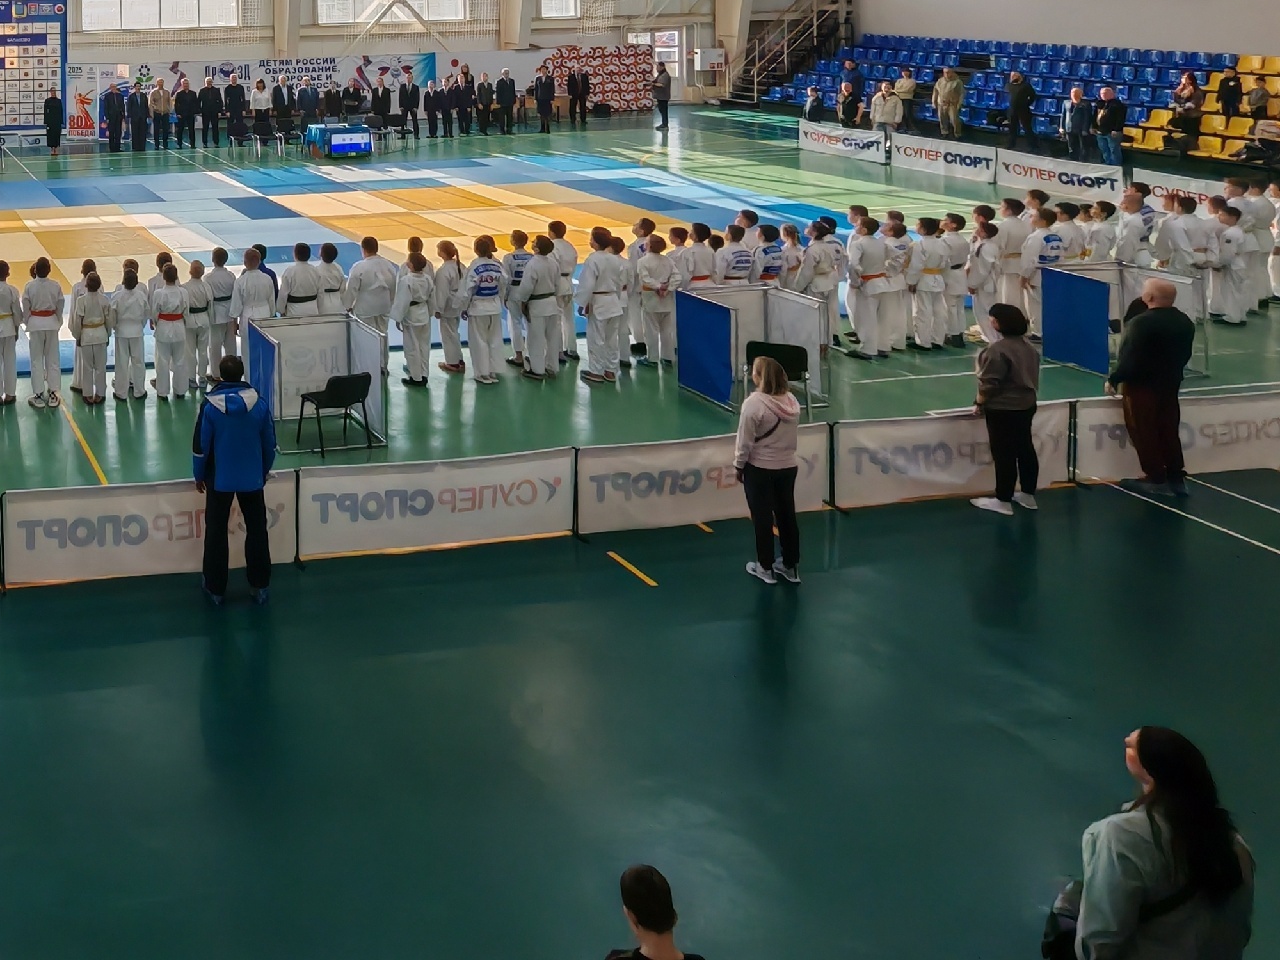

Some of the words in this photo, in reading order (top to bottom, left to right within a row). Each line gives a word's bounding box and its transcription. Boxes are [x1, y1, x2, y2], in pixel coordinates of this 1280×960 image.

[259, 59, 293, 67] ДЕТЯМ
[296, 58, 336, 66] РОССИИ
[68, 66, 83, 74] 2025
[265, 65, 340, 75] ОБРАЗОВАНИЕ,
[271, 74, 322, 83] ЗРОЬЕ
[326, 73, 332, 81] И
[68, 115, 83, 128] 80
[810, 131, 841, 146] СУПЕР
[842, 137, 882, 152] СПОРТ
[903, 146, 942, 161] СУПЕР
[943, 151, 994, 170] СПОРТ
[1012, 163, 1056, 182] СУПЕР
[1057, 172, 1119, 191] СПОРТ
